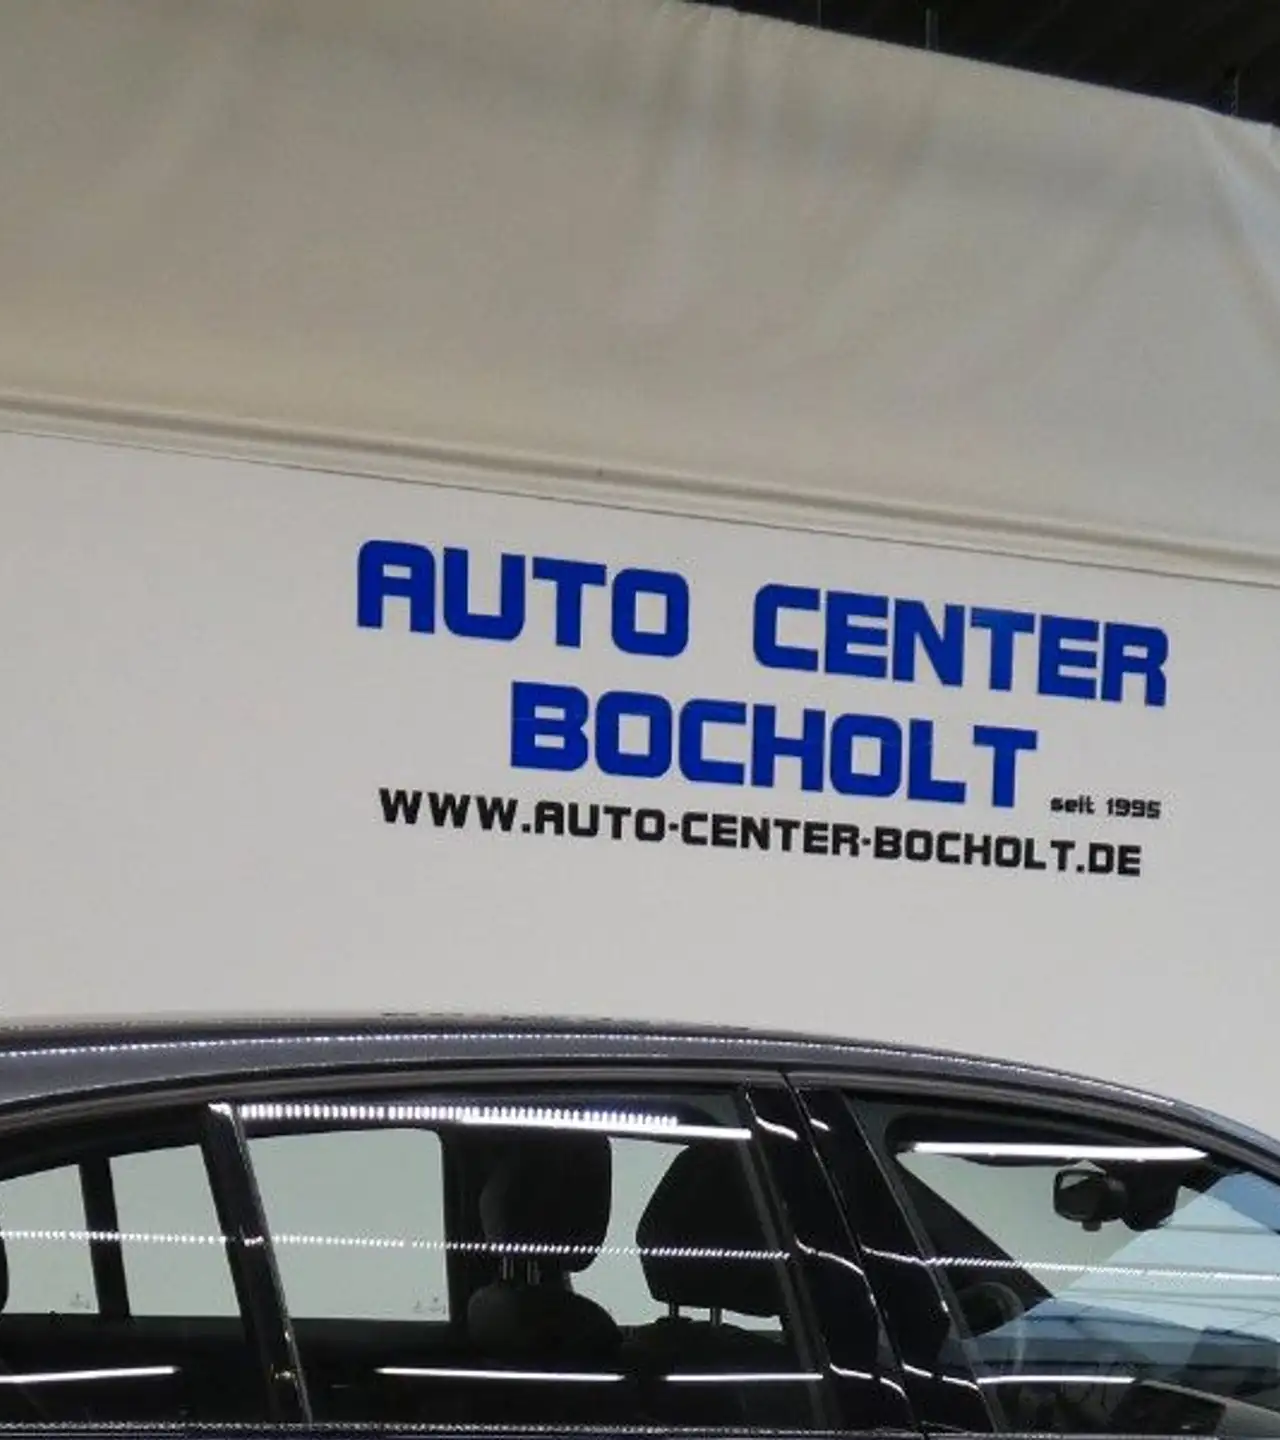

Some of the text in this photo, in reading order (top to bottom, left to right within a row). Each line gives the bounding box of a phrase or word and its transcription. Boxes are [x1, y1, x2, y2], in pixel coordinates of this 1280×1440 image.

[357, 539, 1170, 707] AUTO CENTER
[510, 680, 1040, 809] BOCHOLT
[1050, 795, 1162, 819] seit 1995
